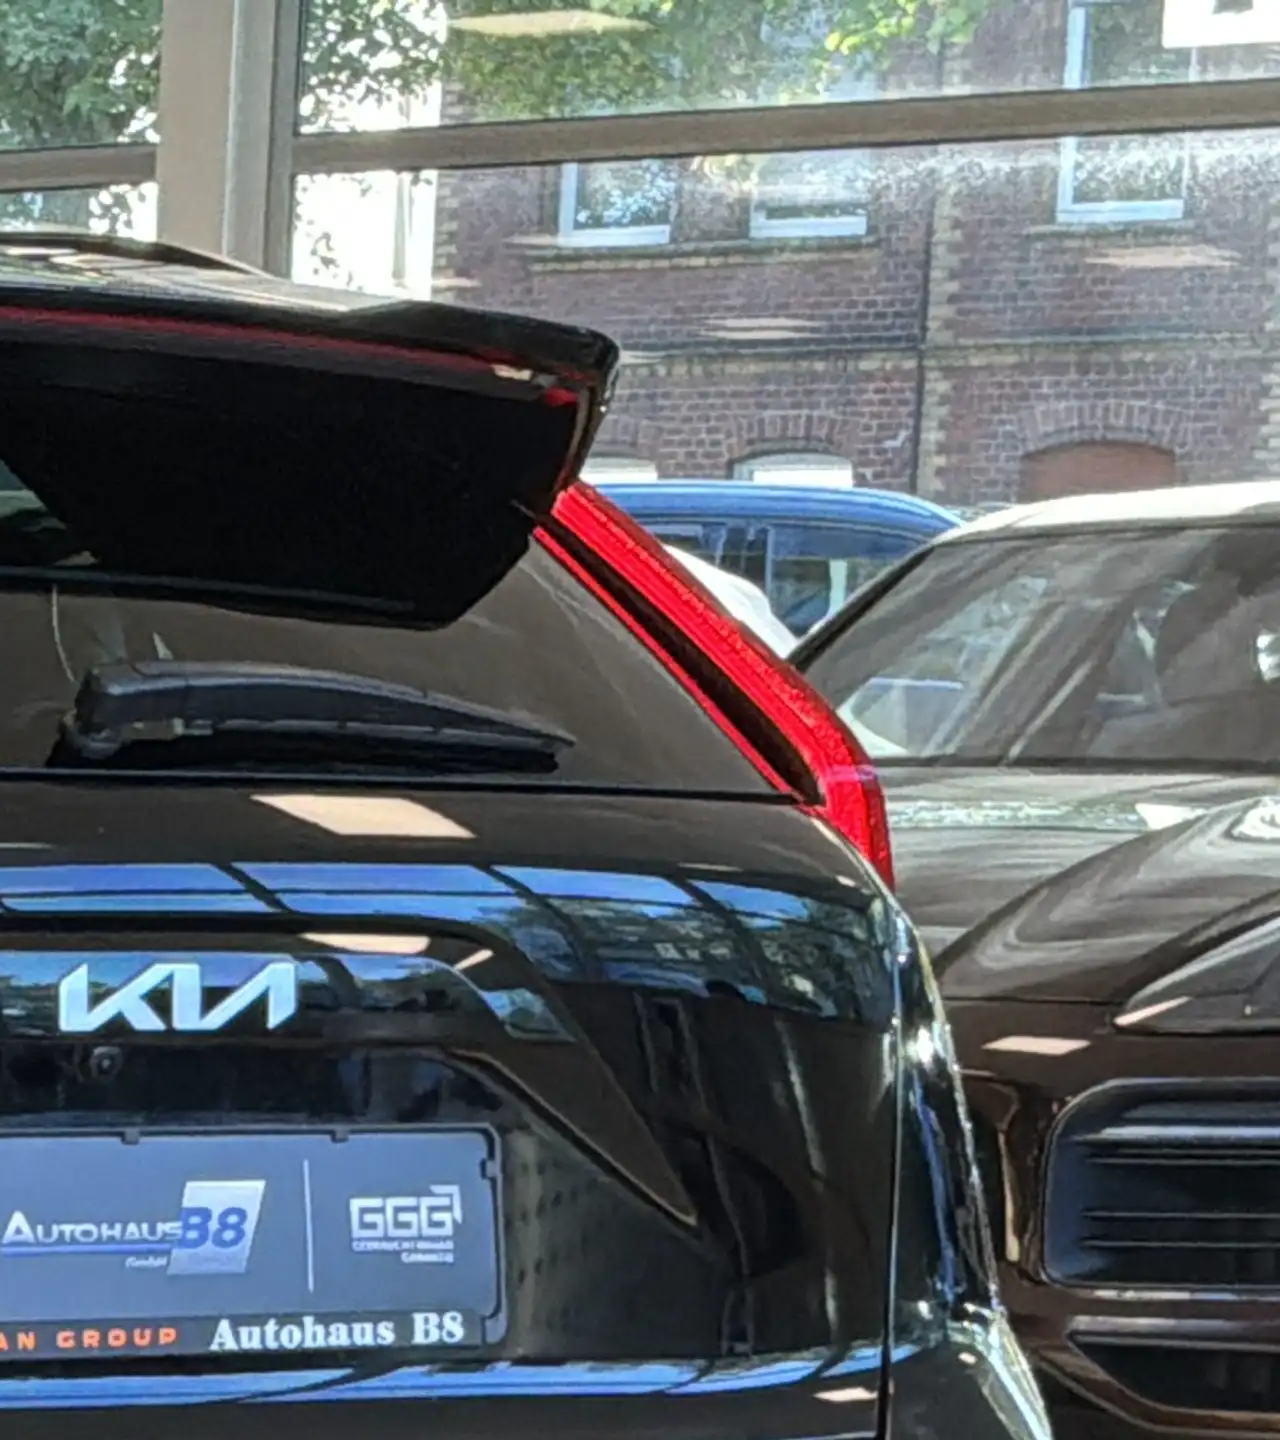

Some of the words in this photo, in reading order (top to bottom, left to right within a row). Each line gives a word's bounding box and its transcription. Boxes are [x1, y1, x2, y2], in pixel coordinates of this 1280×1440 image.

[59, 962, 297, 1032] KIA
[178, 1206, 248, 1249] B8
[349, 1196, 454, 1238] GGG
[55, 1327, 178, 1350] GROUP
[209, 1314, 396, 1351] Autohaus
[410, 1310, 465, 1345] B8
